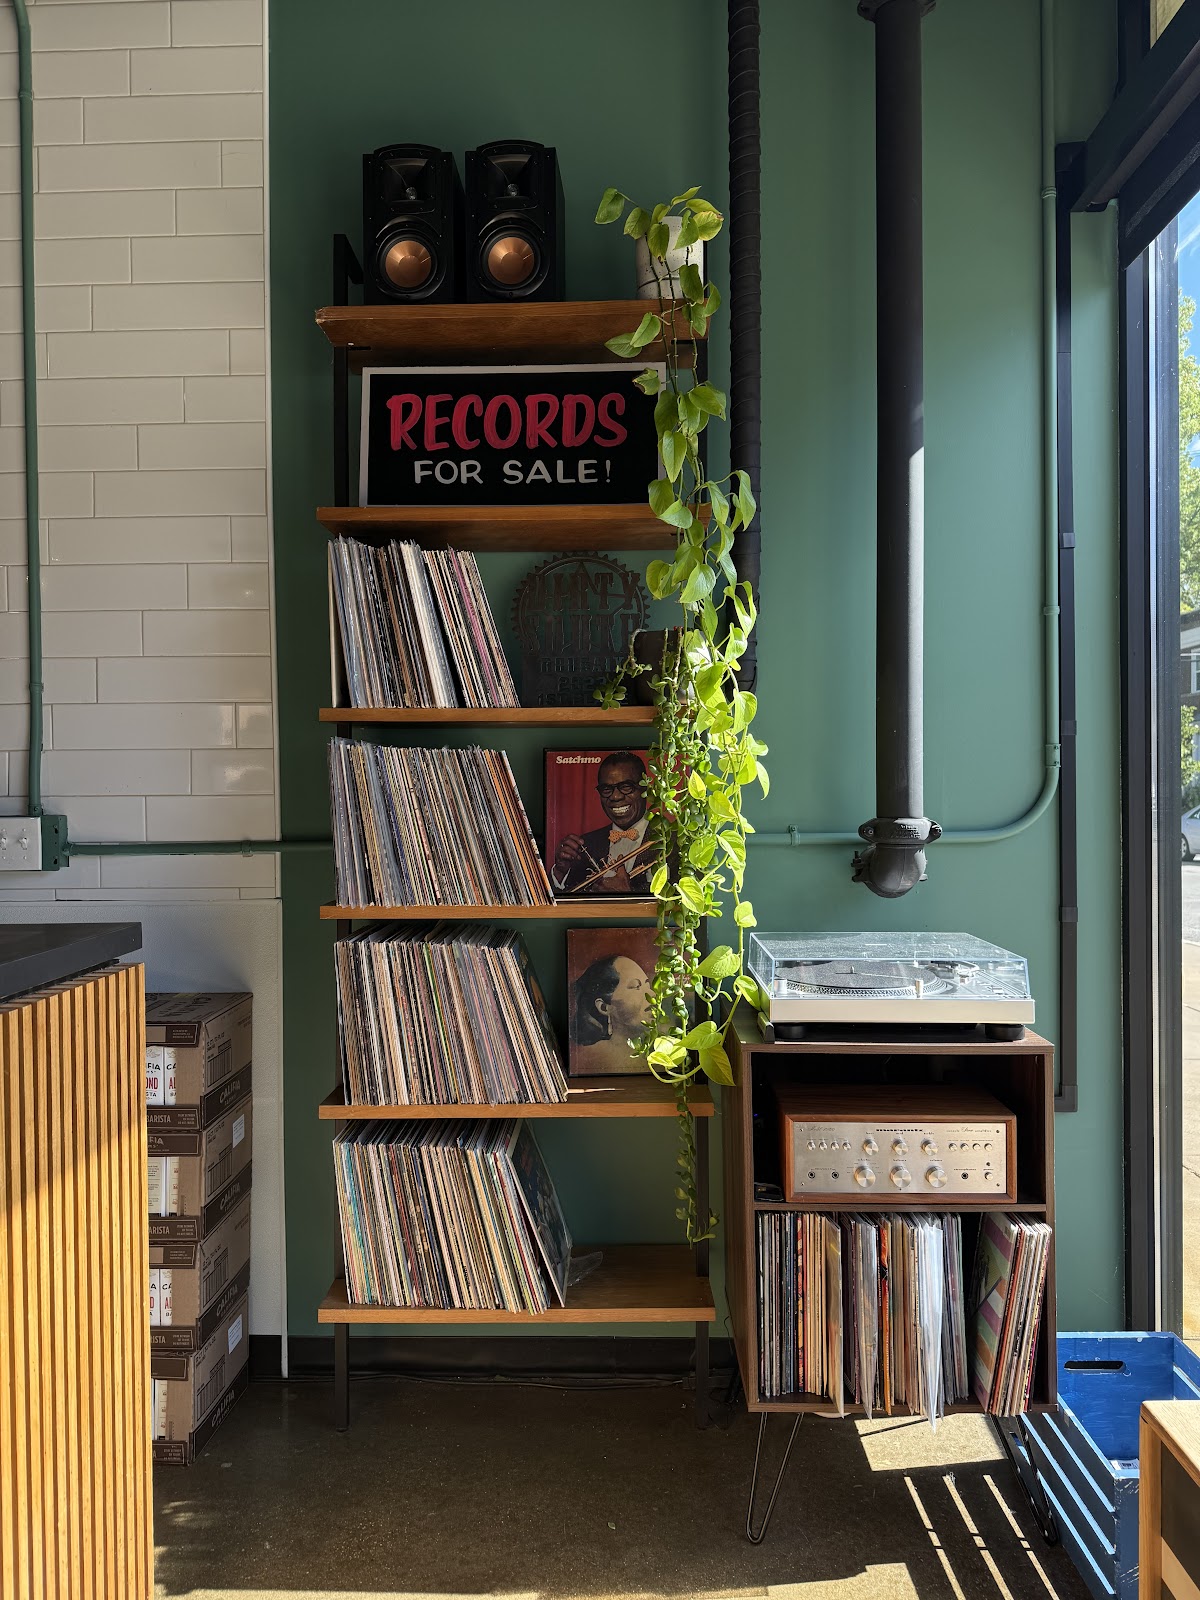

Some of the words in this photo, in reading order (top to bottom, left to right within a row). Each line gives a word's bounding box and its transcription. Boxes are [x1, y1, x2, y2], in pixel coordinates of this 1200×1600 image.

[386, 393, 628, 450] RECORDS
[414, 459, 484, 484] FOR
[502, 459, 612, 484] SALE!
[555, 755, 602, 765] Satchmo
[219, 1079, 241, 1104] CALIFIA
[149, 1225, 170, 1235] ARISTA
